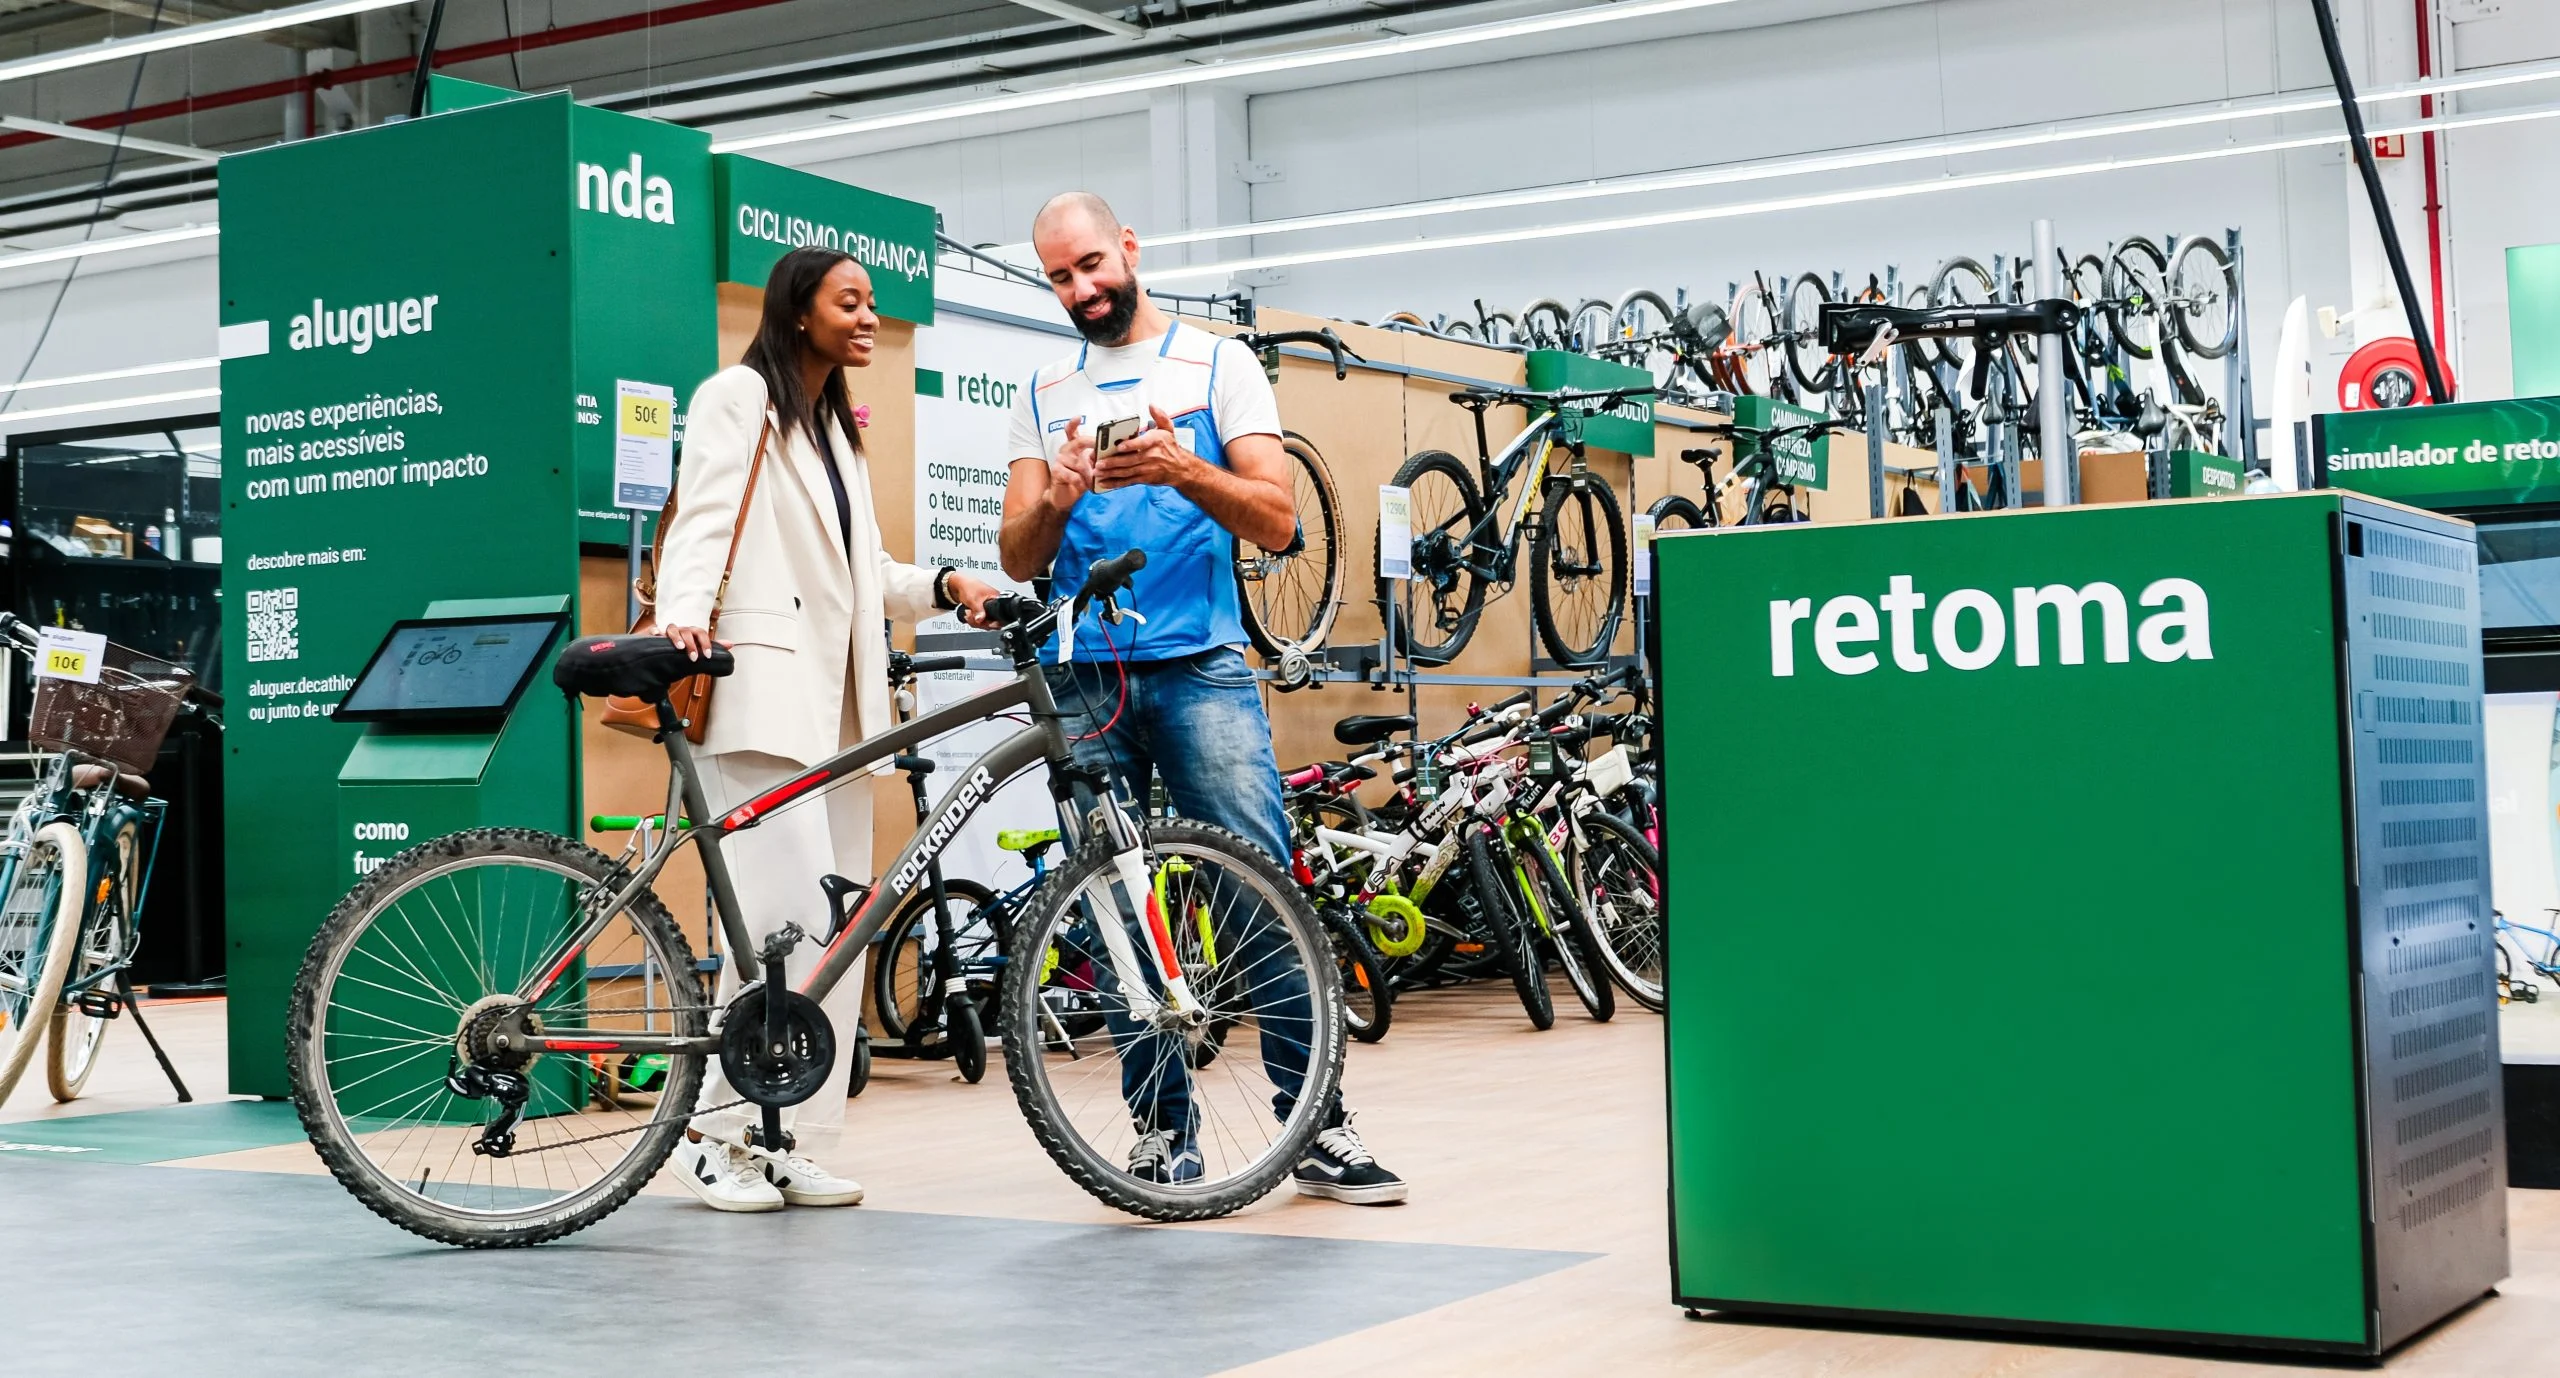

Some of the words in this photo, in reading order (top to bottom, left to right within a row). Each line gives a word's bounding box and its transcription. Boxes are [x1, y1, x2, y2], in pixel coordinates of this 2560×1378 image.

[578, 152, 675, 225] nda
[738, 204, 839, 251] CICLISMO
[844, 231, 929, 283] CRIANÇA
[289, 294, 439, 355] aluguer
[246, 409, 305, 434] novas
[310, 388, 443, 430] experiências,
[635, 405, 658, 424] 50€
[246, 438, 295, 467] mais
[299, 425, 405, 461] acessíveis
[2327, 442, 2458, 471] simulador
[2463, 439, 2498, 463] de
[2503, 438, 2560, 461] reto
[246, 475, 289, 500] com
[294, 472, 327, 495] um
[332, 463, 398, 491] menor
[403, 452, 489, 487] impacto
[928, 462, 1009, 488] compramos
[929, 492, 938, 509] o
[941, 490, 963, 512] teu
[247, 551, 306, 571] descobre
[307, 546, 340, 565] mais
[342, 548, 367, 562] em:
[930, 555, 936, 566] e
[937, 554, 979, 570] damos-lhe
[981, 560, 998, 572] uma
[1769, 575, 2214, 677] retoma
[54, 656, 80, 670] 10€
[249, 674, 357, 699] aluguer.decathlo
[249, 707, 265, 720] ou
[267, 703, 301, 723] junto
[303, 701, 320, 717] de
[1424, 801, 1446, 824] TWIN
[353, 822, 410, 840] como
[890, 765, 994, 896] ROCKRIDER
[1328, 1001, 1339, 1063] MICHELIN
[1317, 1067, 1334, 1100] Country
[555, 1184, 614, 1223] MICHELIN
[514, 1218, 550, 1231] Country
